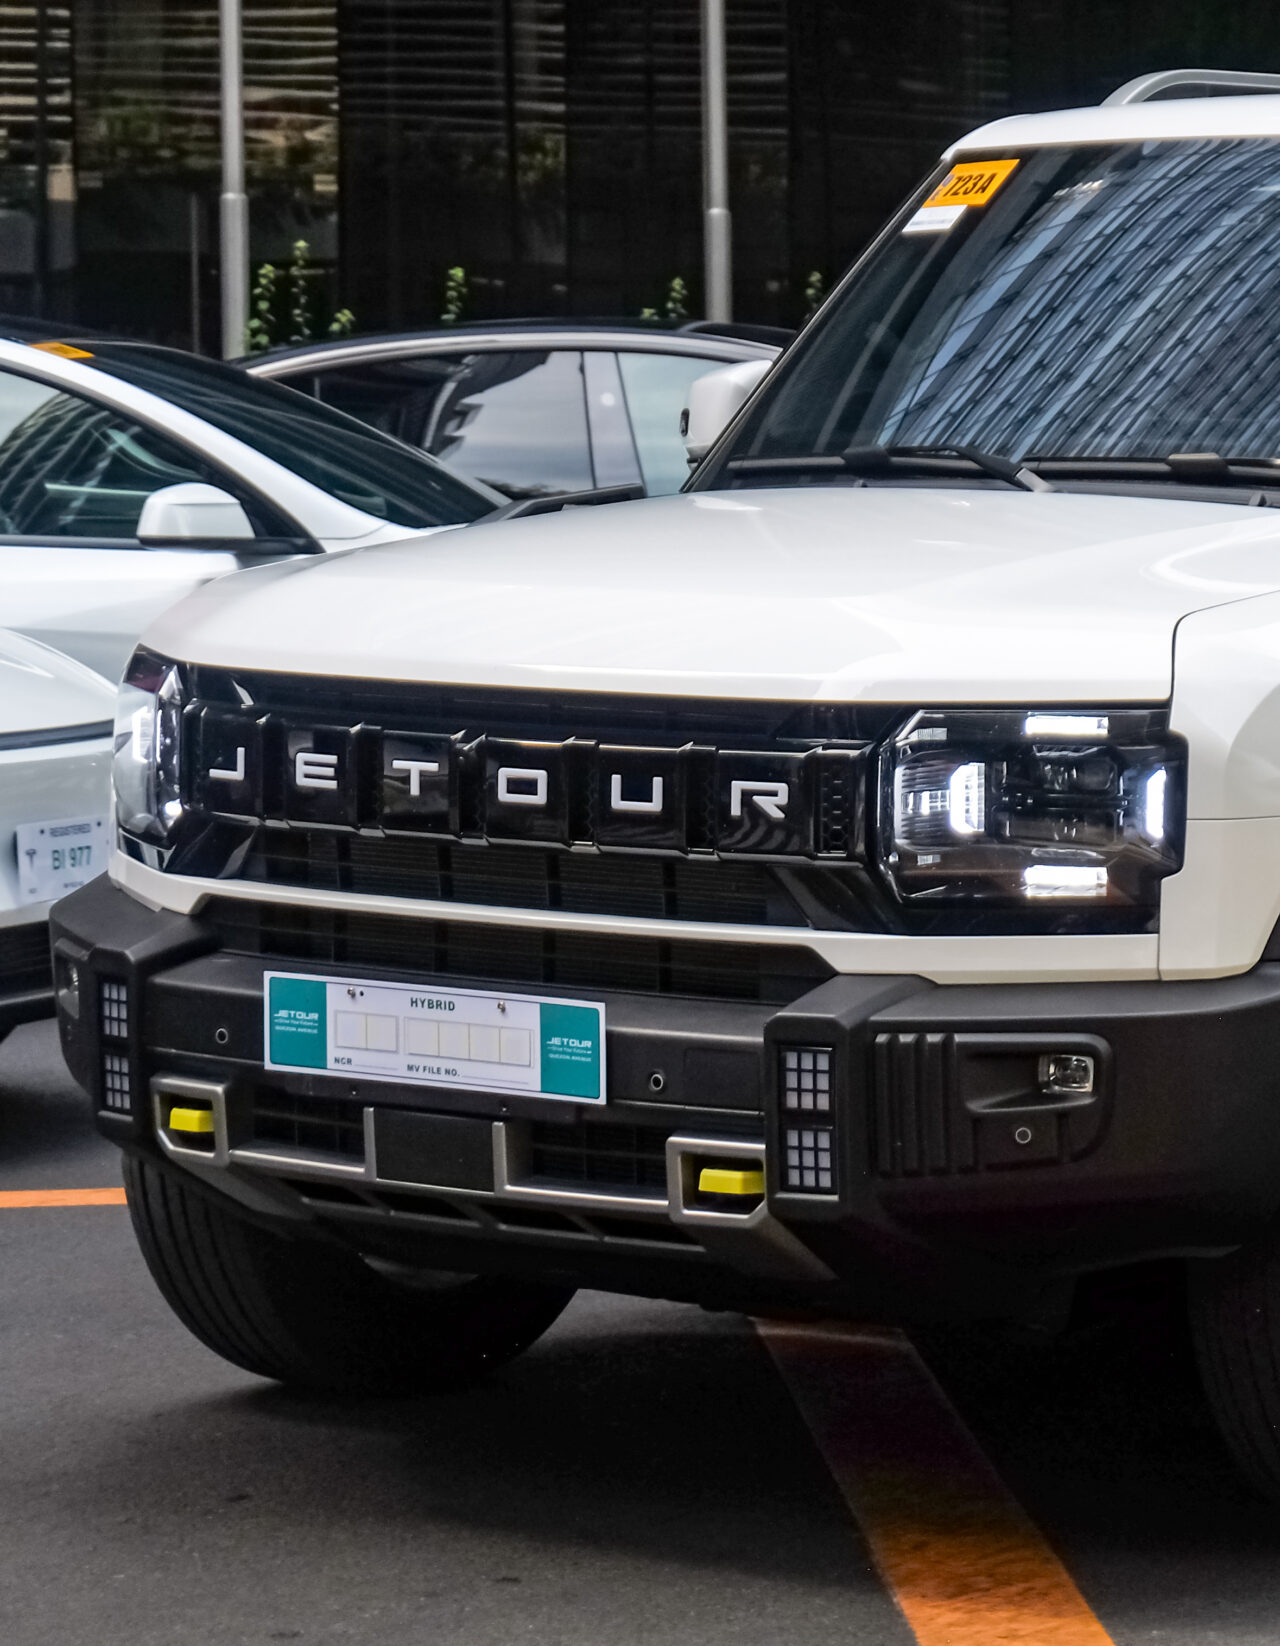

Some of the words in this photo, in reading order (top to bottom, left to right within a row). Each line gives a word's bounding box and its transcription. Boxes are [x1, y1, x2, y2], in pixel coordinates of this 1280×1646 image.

[208, 746, 790, 820] JETOUR
[69, 845, 91, 868] 977
[410, 997, 455, 1011] HYBRID
[274, 1009, 319, 1020] JETOUR
[546, 1036, 592, 1049] JETOUR
[334, 1056, 353, 1066] NCR
[406, 1064, 420, 1073] MV
[422, 1065, 441, 1075] FILE
[444, 1067, 460, 1077] NO.
